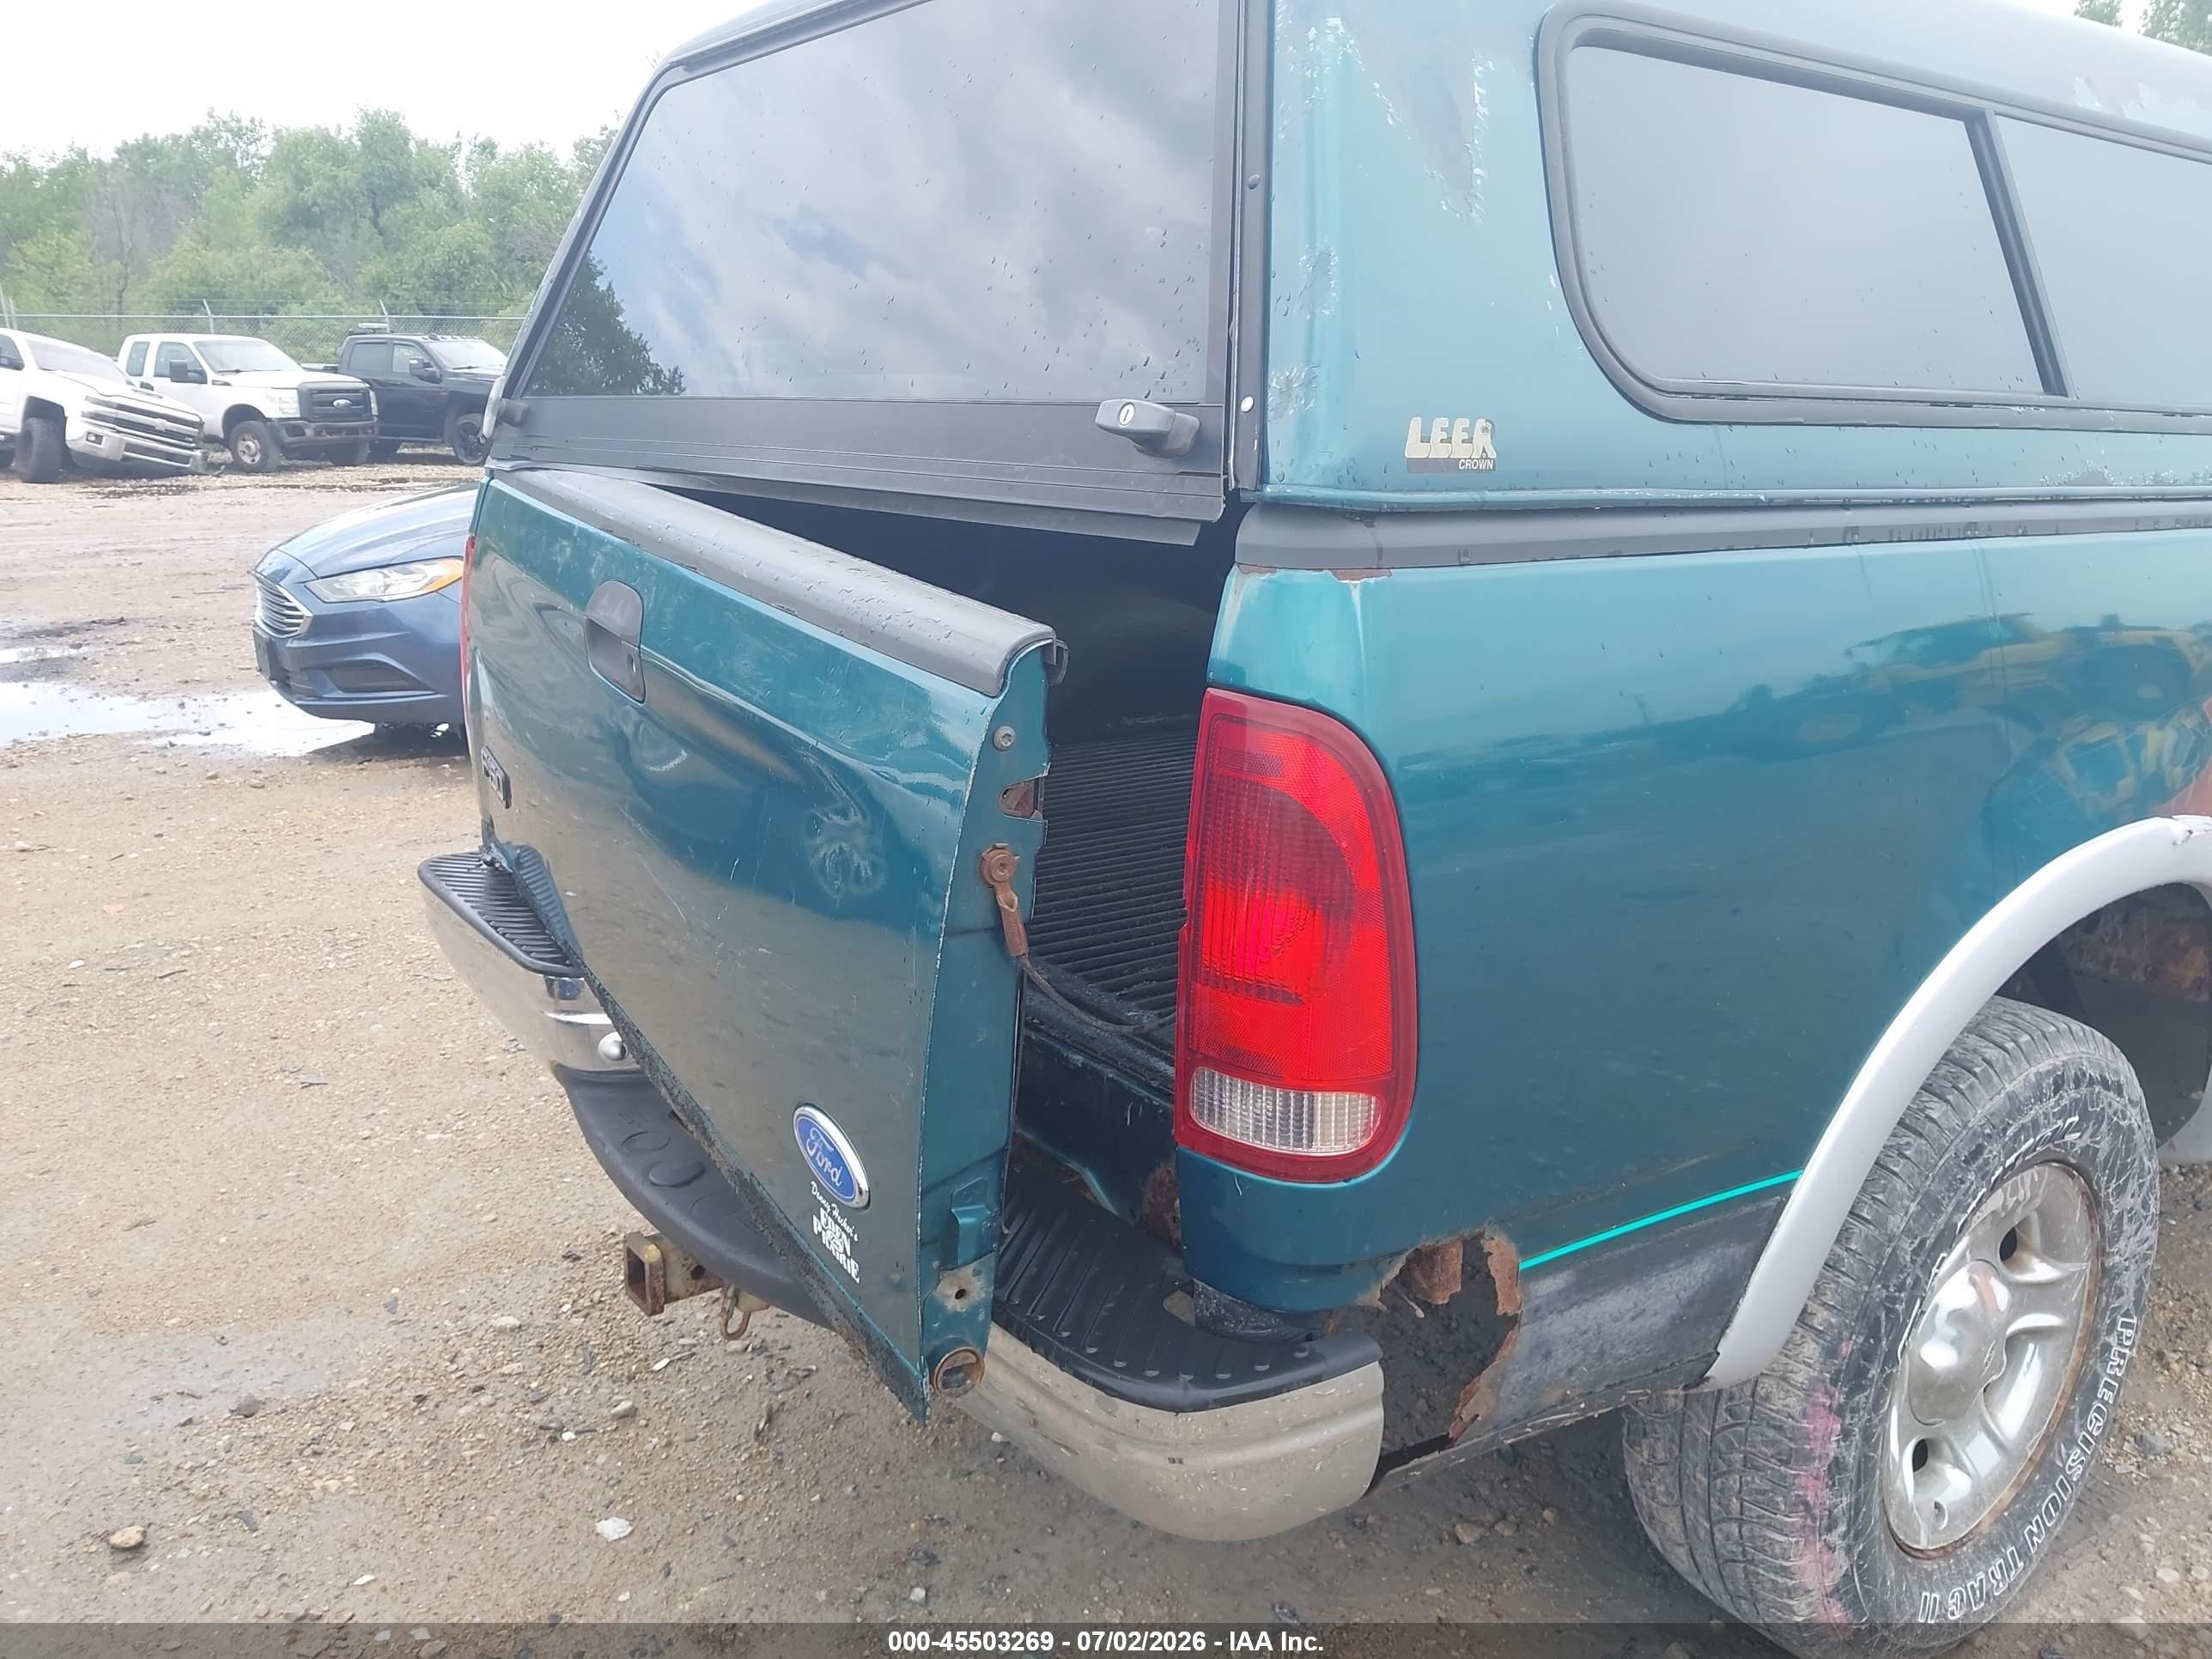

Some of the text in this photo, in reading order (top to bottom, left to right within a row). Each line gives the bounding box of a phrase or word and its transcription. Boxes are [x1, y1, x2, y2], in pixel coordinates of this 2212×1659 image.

[1404, 416, 1497, 459] LEER
[1458, 459, 1494, 471] CROWN
[805, 1127, 843, 1188] Ford
[811, 1214, 860, 1284] PRAIRIE
[819, 1207, 851, 1257] EDEN
[1917, 1315, 2138, 1625] PRECISION TRAC II
